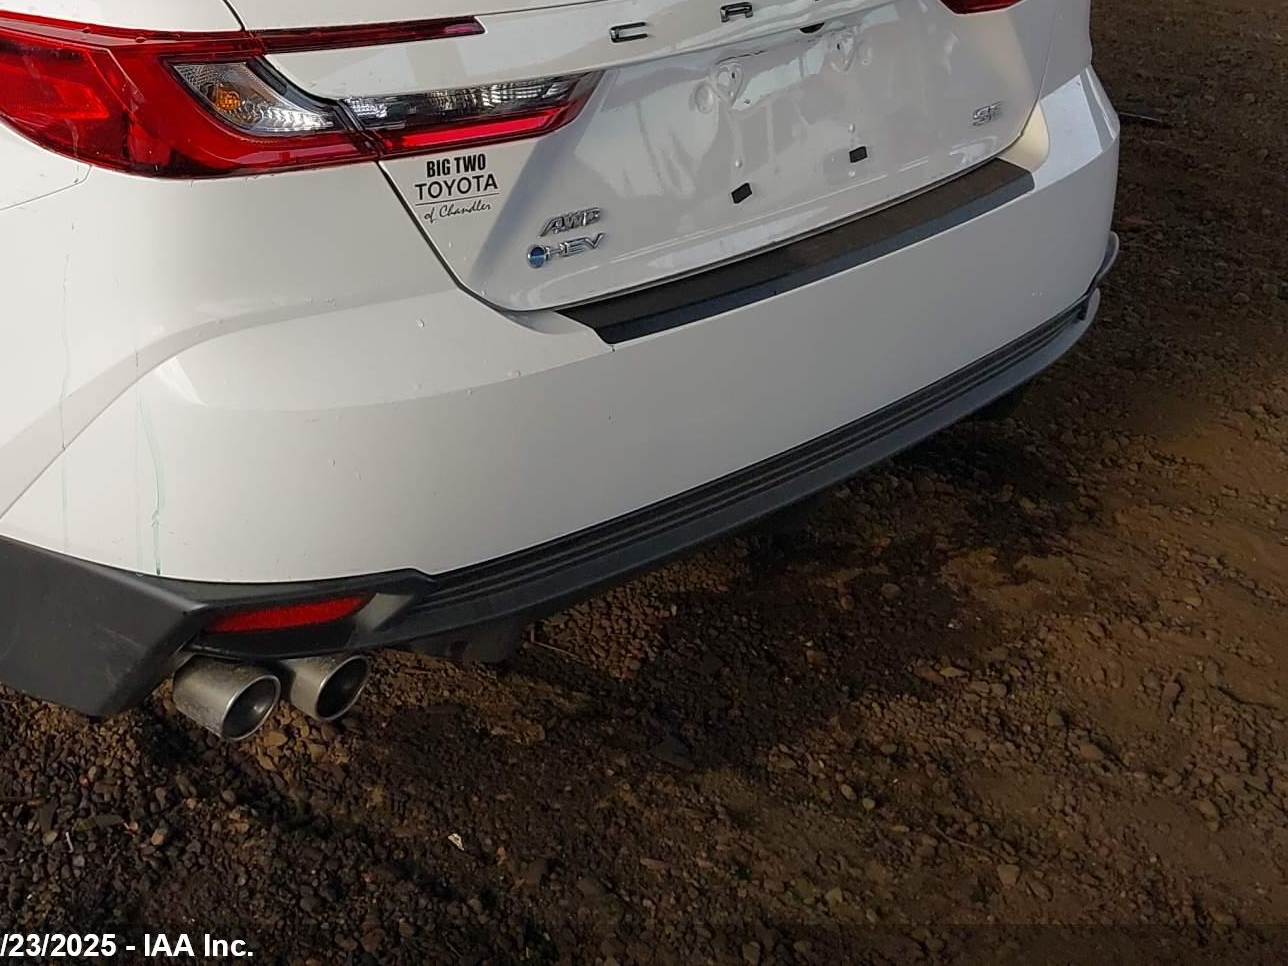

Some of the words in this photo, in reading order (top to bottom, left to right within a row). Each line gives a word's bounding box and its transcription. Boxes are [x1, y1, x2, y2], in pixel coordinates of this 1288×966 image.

[426, 158, 451, 179] BIG
[454, 153, 486, 173] TWO
[414, 173, 499, 201] TOYOTA
[424, 207, 437, 224] of
[439, 199, 491, 219] Chandler
[537, 207, 603, 239] AWD
[544, 232, 607, 261] HEV
